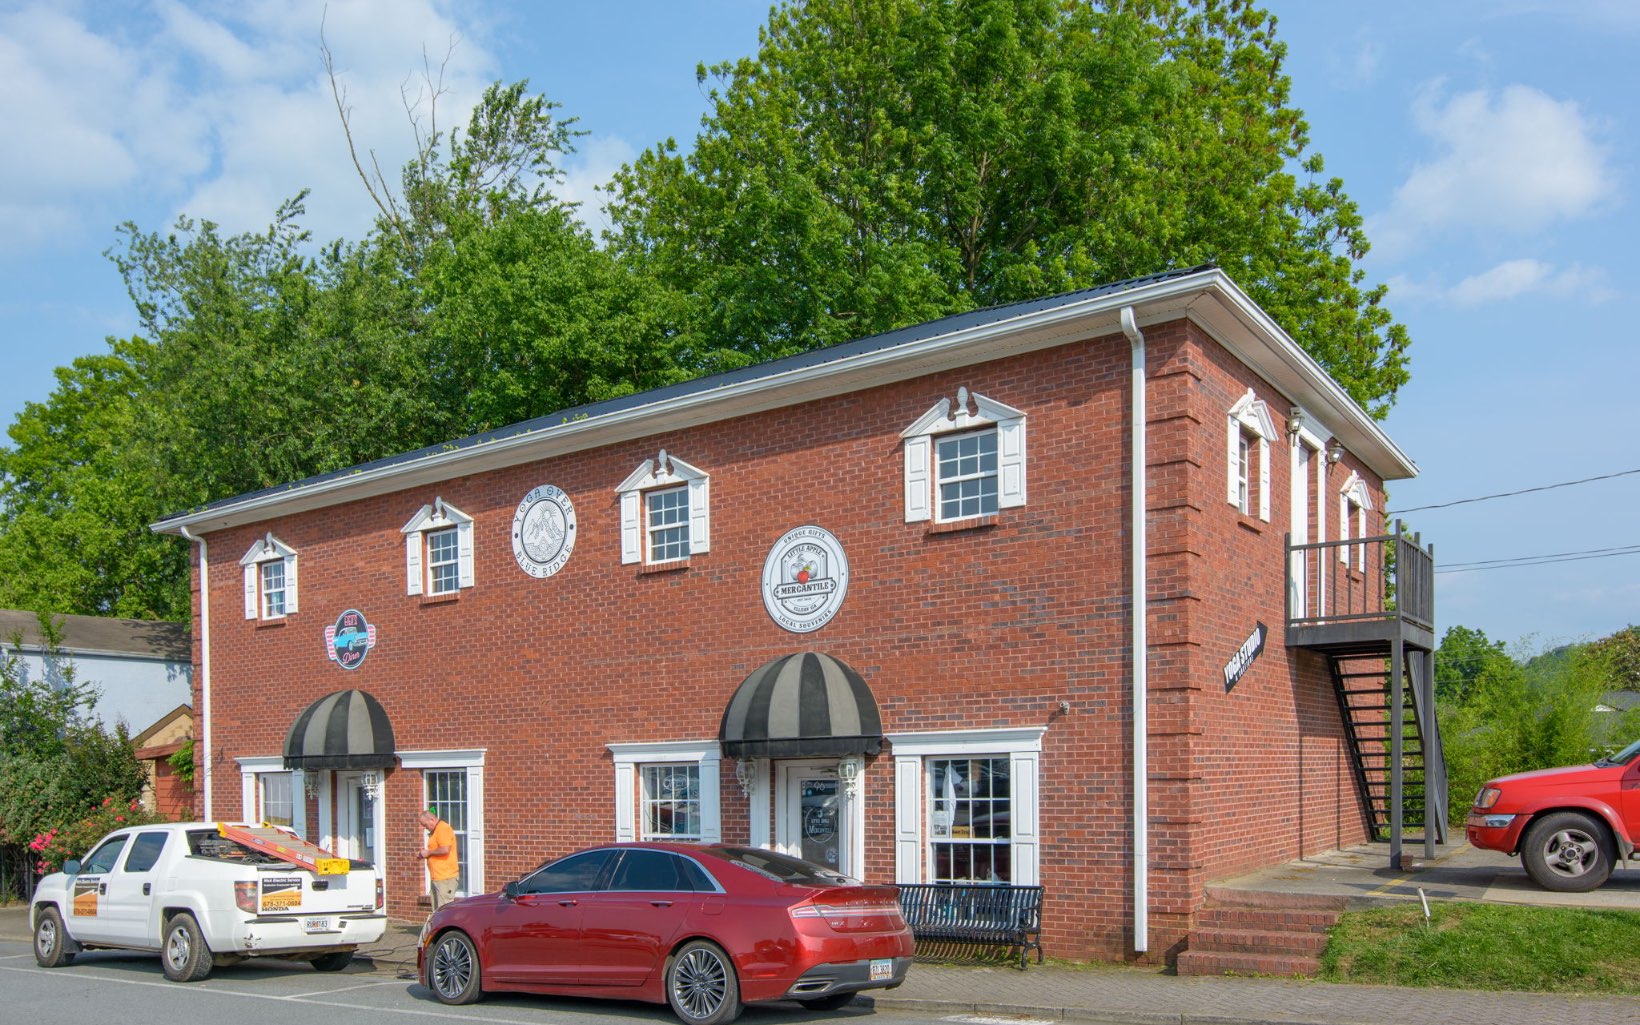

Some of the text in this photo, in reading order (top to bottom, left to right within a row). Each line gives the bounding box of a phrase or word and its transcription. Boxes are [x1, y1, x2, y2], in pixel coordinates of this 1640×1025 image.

[514, 486, 573, 523] YOGA OVER
[783, 529, 826, 544] UNIQUE GIFTS
[516, 544, 572, 577] BLUE RIDGE
[787, 545, 822, 559] LITTLE APPLE
[781, 581, 829, 595] MERCANTILE
[778, 609, 832, 629] LOCAL SOUVENIRS
[1223, 651, 1241, 685] YOGA
[1239, 627, 1261, 666] STUDIO
